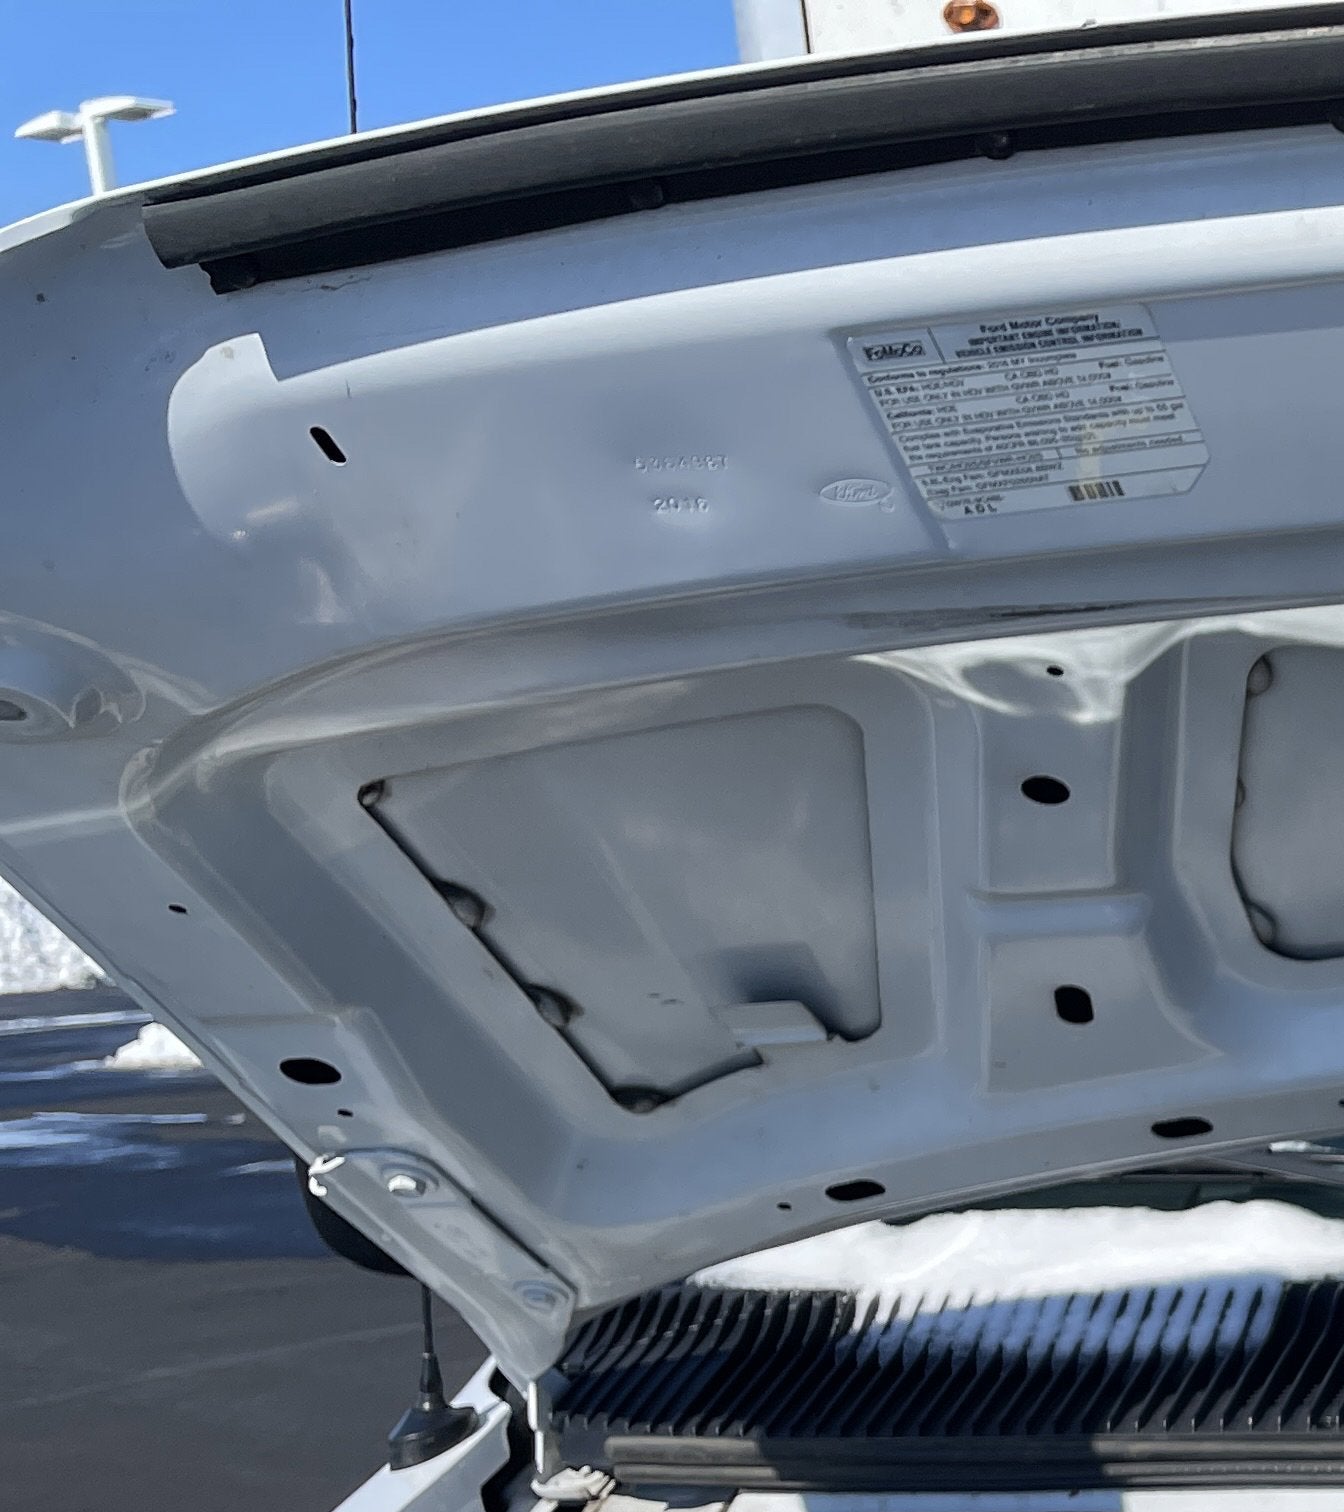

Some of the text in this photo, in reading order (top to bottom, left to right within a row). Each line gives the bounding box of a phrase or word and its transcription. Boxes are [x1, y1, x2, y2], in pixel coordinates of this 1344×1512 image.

[979, 312, 1100, 333] Ford Motor Company
[1080, 329, 1143, 342] INFORMATION
[867, 373, 914, 383] Conforms
